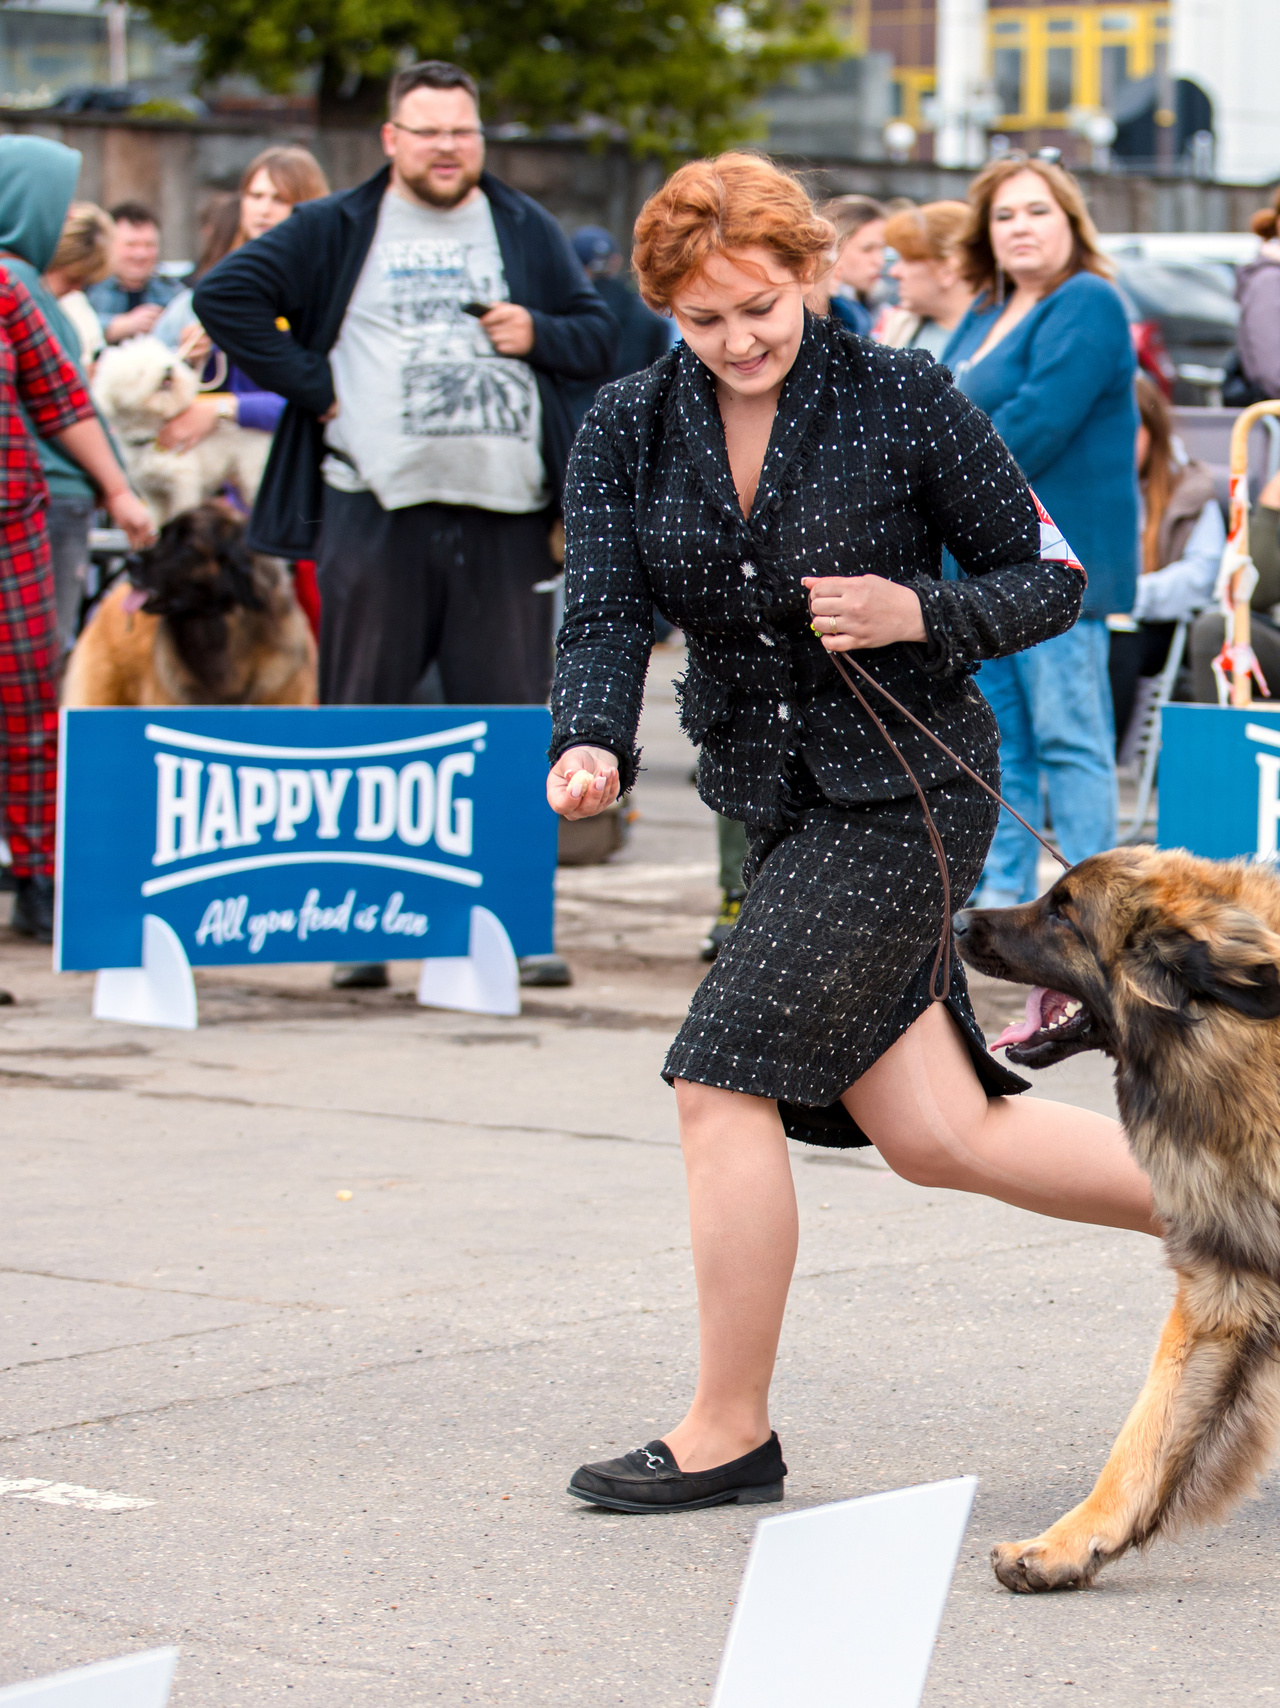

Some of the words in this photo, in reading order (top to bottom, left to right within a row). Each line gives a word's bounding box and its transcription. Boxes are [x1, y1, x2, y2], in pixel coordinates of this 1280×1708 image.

[152, 752, 352, 866] HAPPY
[354, 752, 475, 857] DOG
[196, 895, 247, 946] All
[248, 909, 297, 954] you
[298, 888, 356, 941] feed
